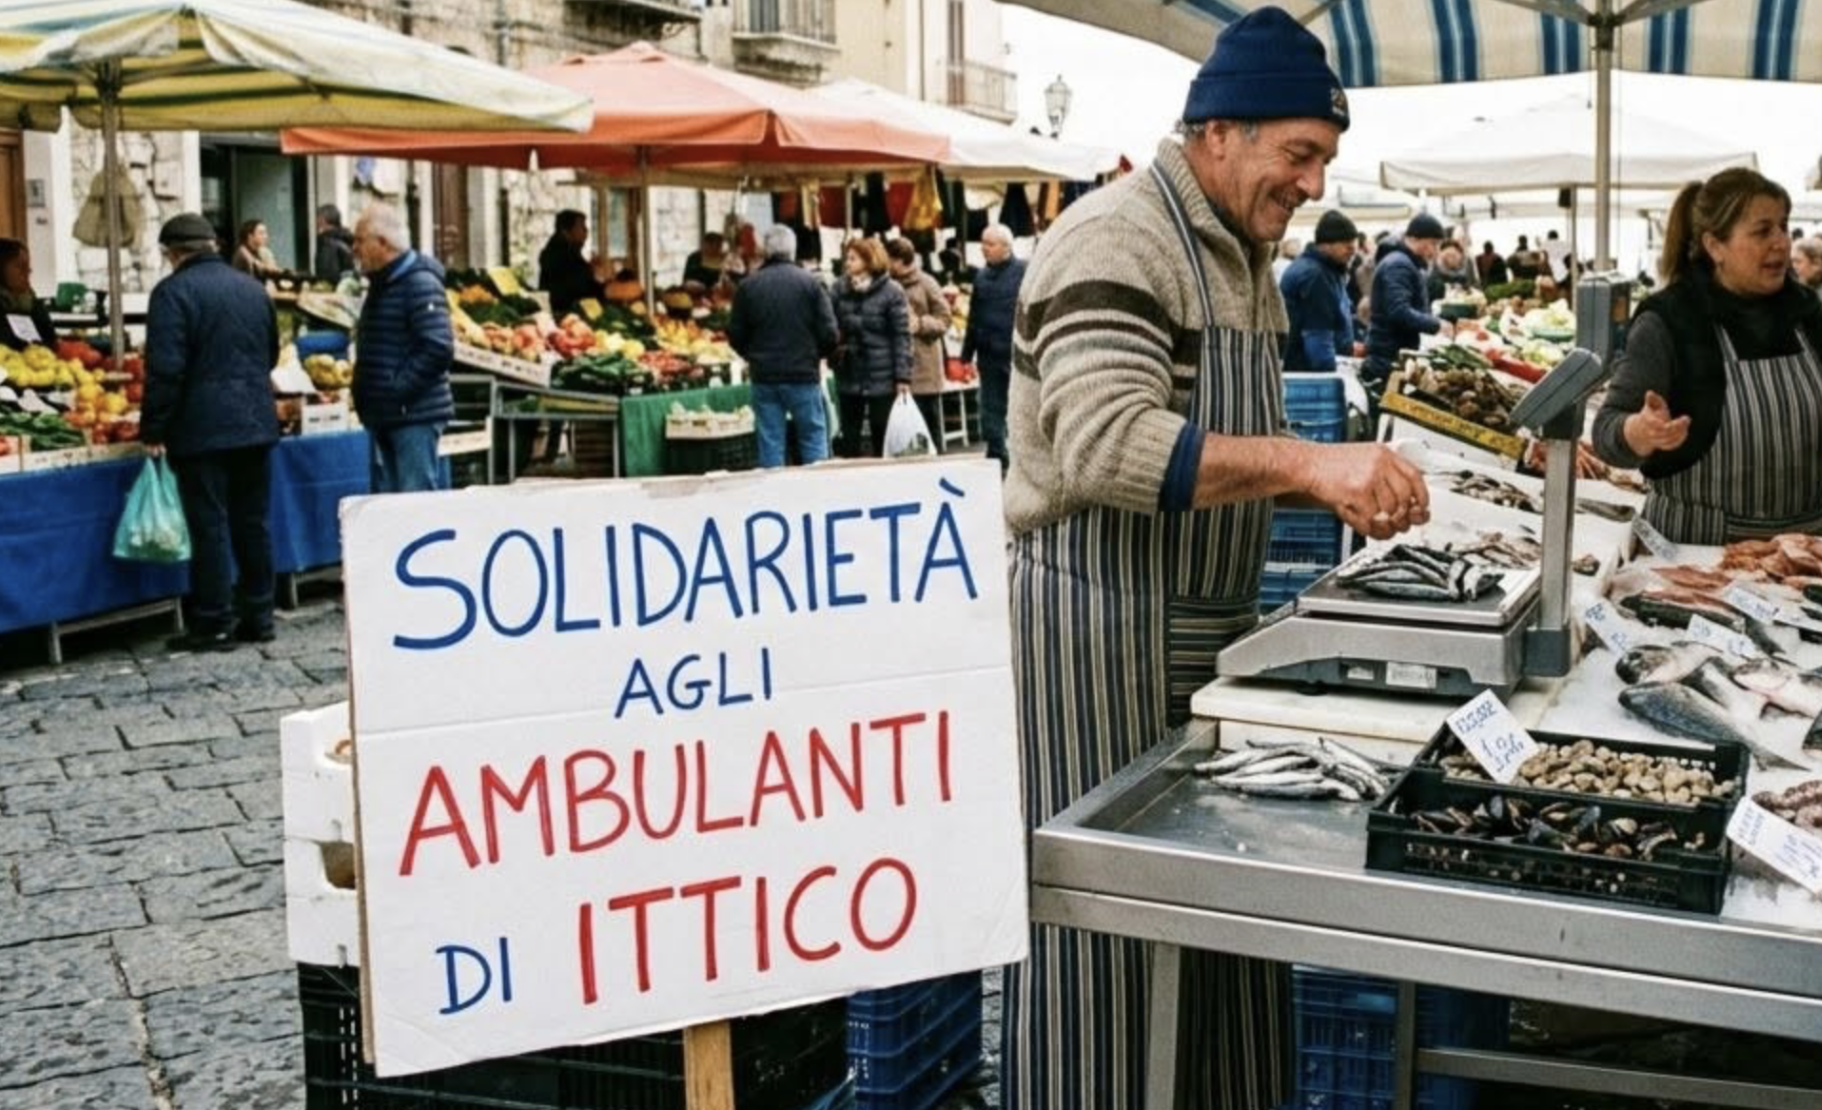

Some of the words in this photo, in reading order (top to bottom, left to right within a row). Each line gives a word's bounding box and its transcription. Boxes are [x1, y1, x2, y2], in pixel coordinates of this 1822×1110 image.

[393, 478, 978, 651] SOLIDARIETÀ
[614, 647, 772, 718] AGLI
[398, 710, 952, 877] AMBULANTI
[435, 936, 512, 1015] DI
[577, 856, 918, 1005] ITTICO
